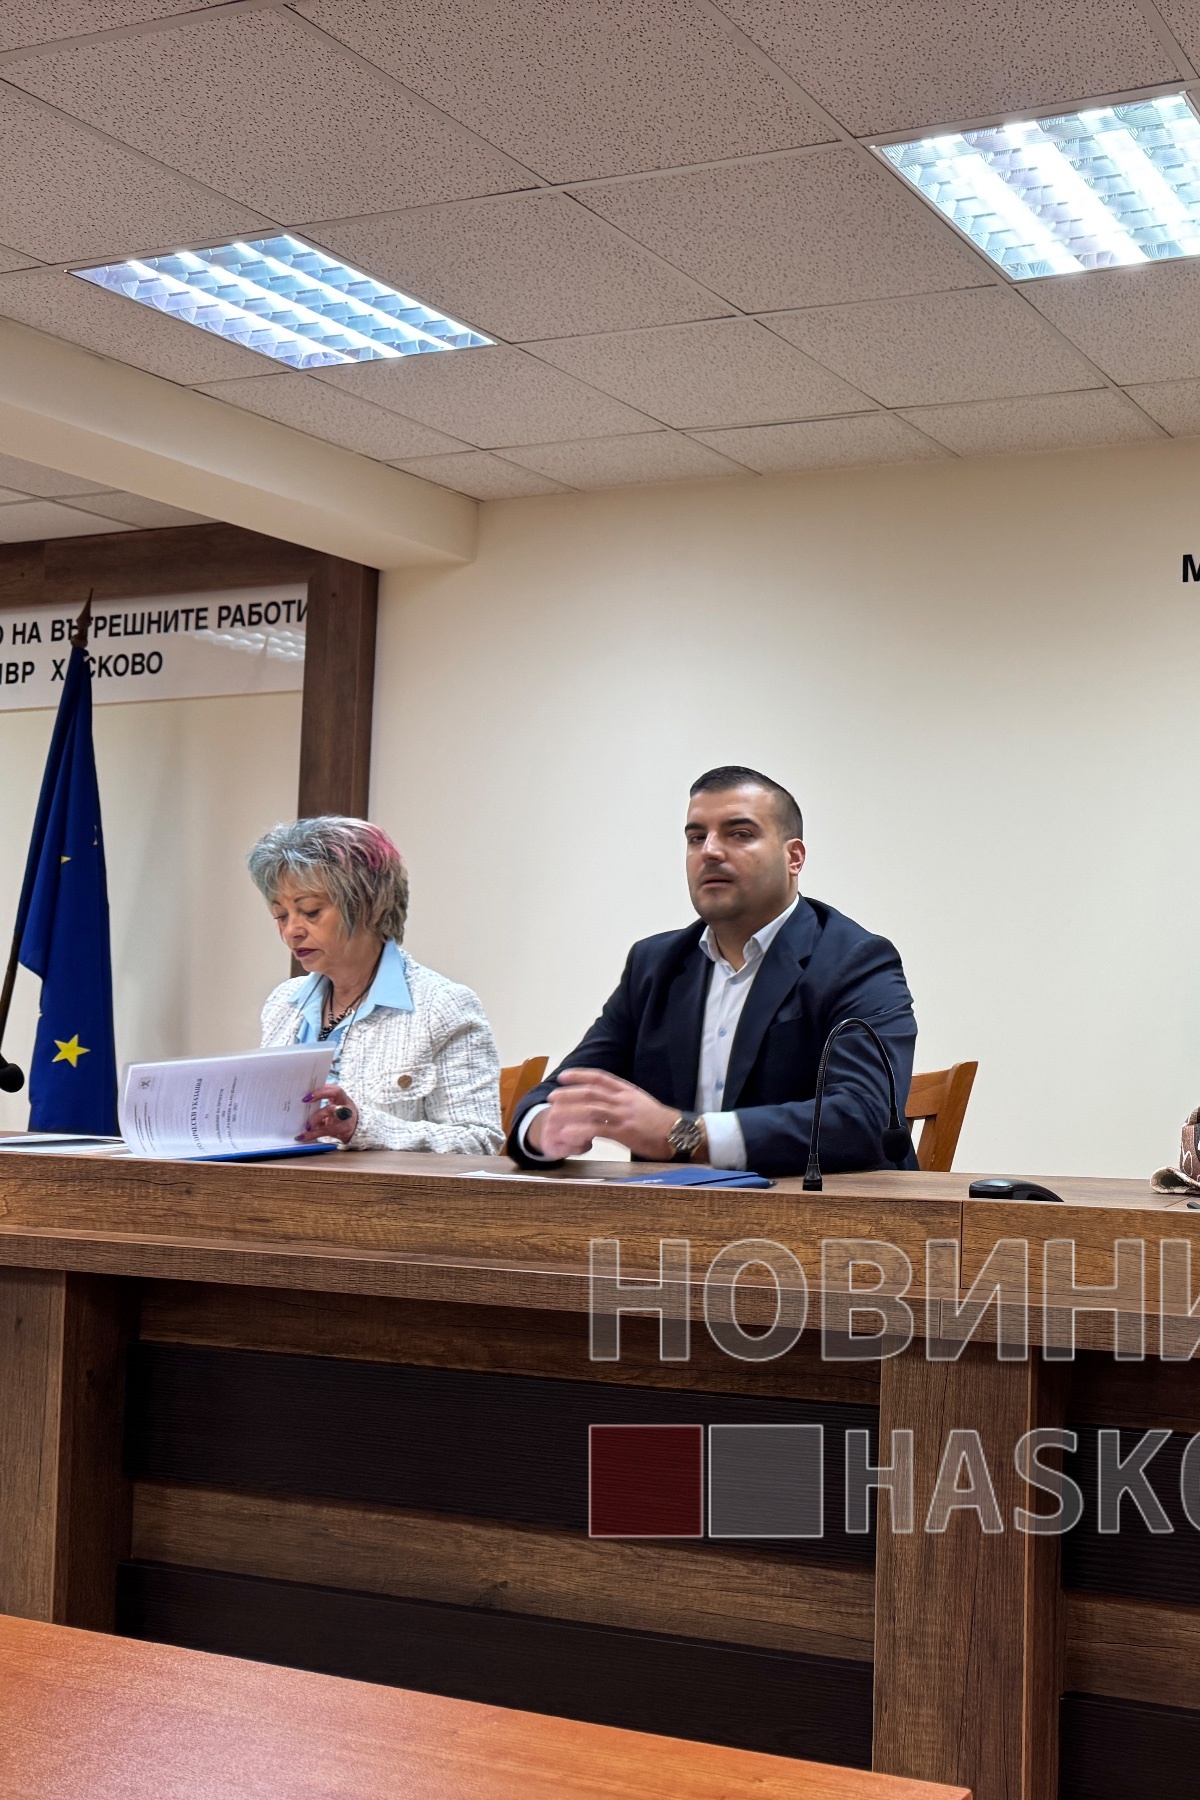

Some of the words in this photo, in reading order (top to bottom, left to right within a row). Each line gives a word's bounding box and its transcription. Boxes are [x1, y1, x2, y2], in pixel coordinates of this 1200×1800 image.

[12, 622, 42, 645] НА
[51, 607, 209, 642] ВЪРЕШНИТЕ
[0, 661, 35, 686] ВР
[51, 651, 163, 681] ХСКОВО
